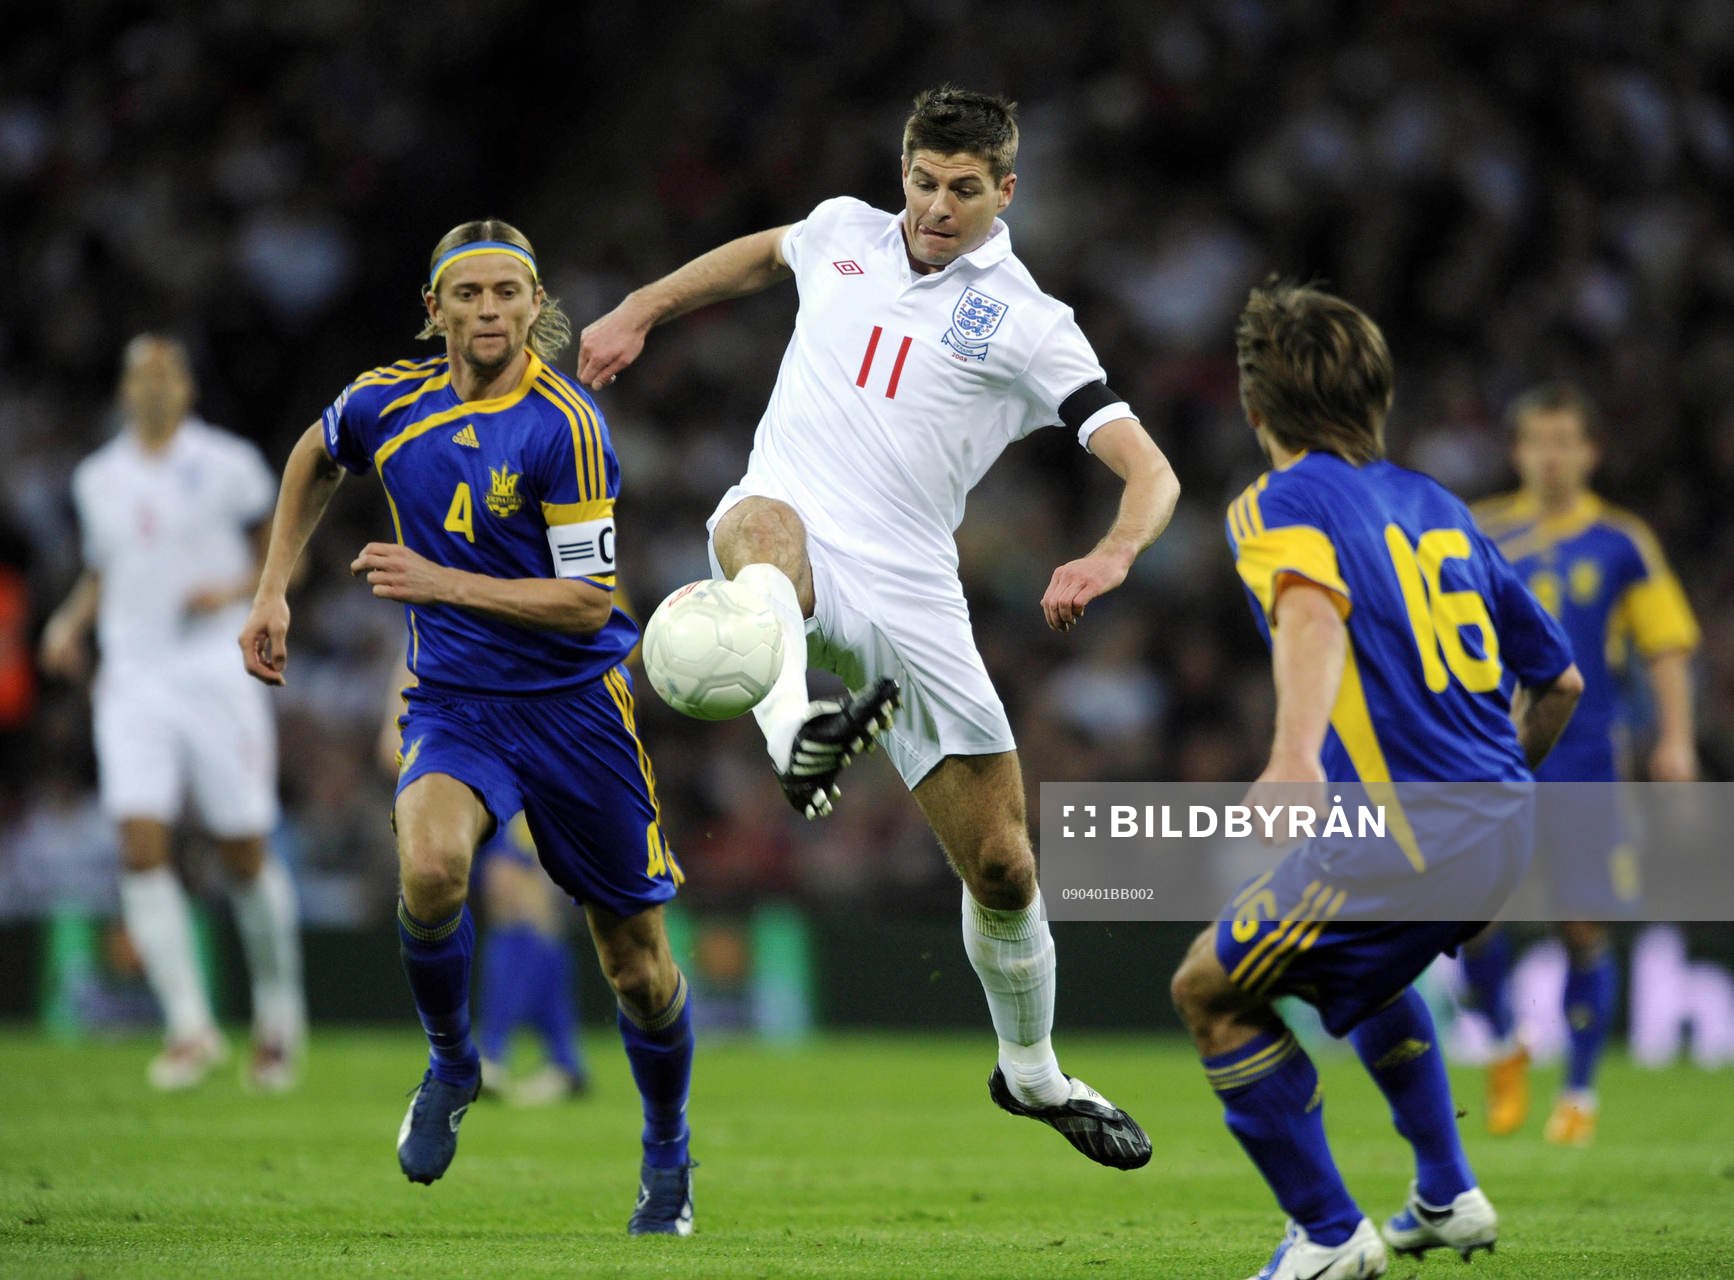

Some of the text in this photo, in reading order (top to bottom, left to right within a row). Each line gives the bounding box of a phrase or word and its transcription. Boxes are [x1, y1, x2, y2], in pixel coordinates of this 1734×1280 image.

[855, 325, 913, 400] 11
[443, 481, 475, 543] 4
[1384, 523, 1503, 694] 16
[1232, 869, 1277, 943] 16
